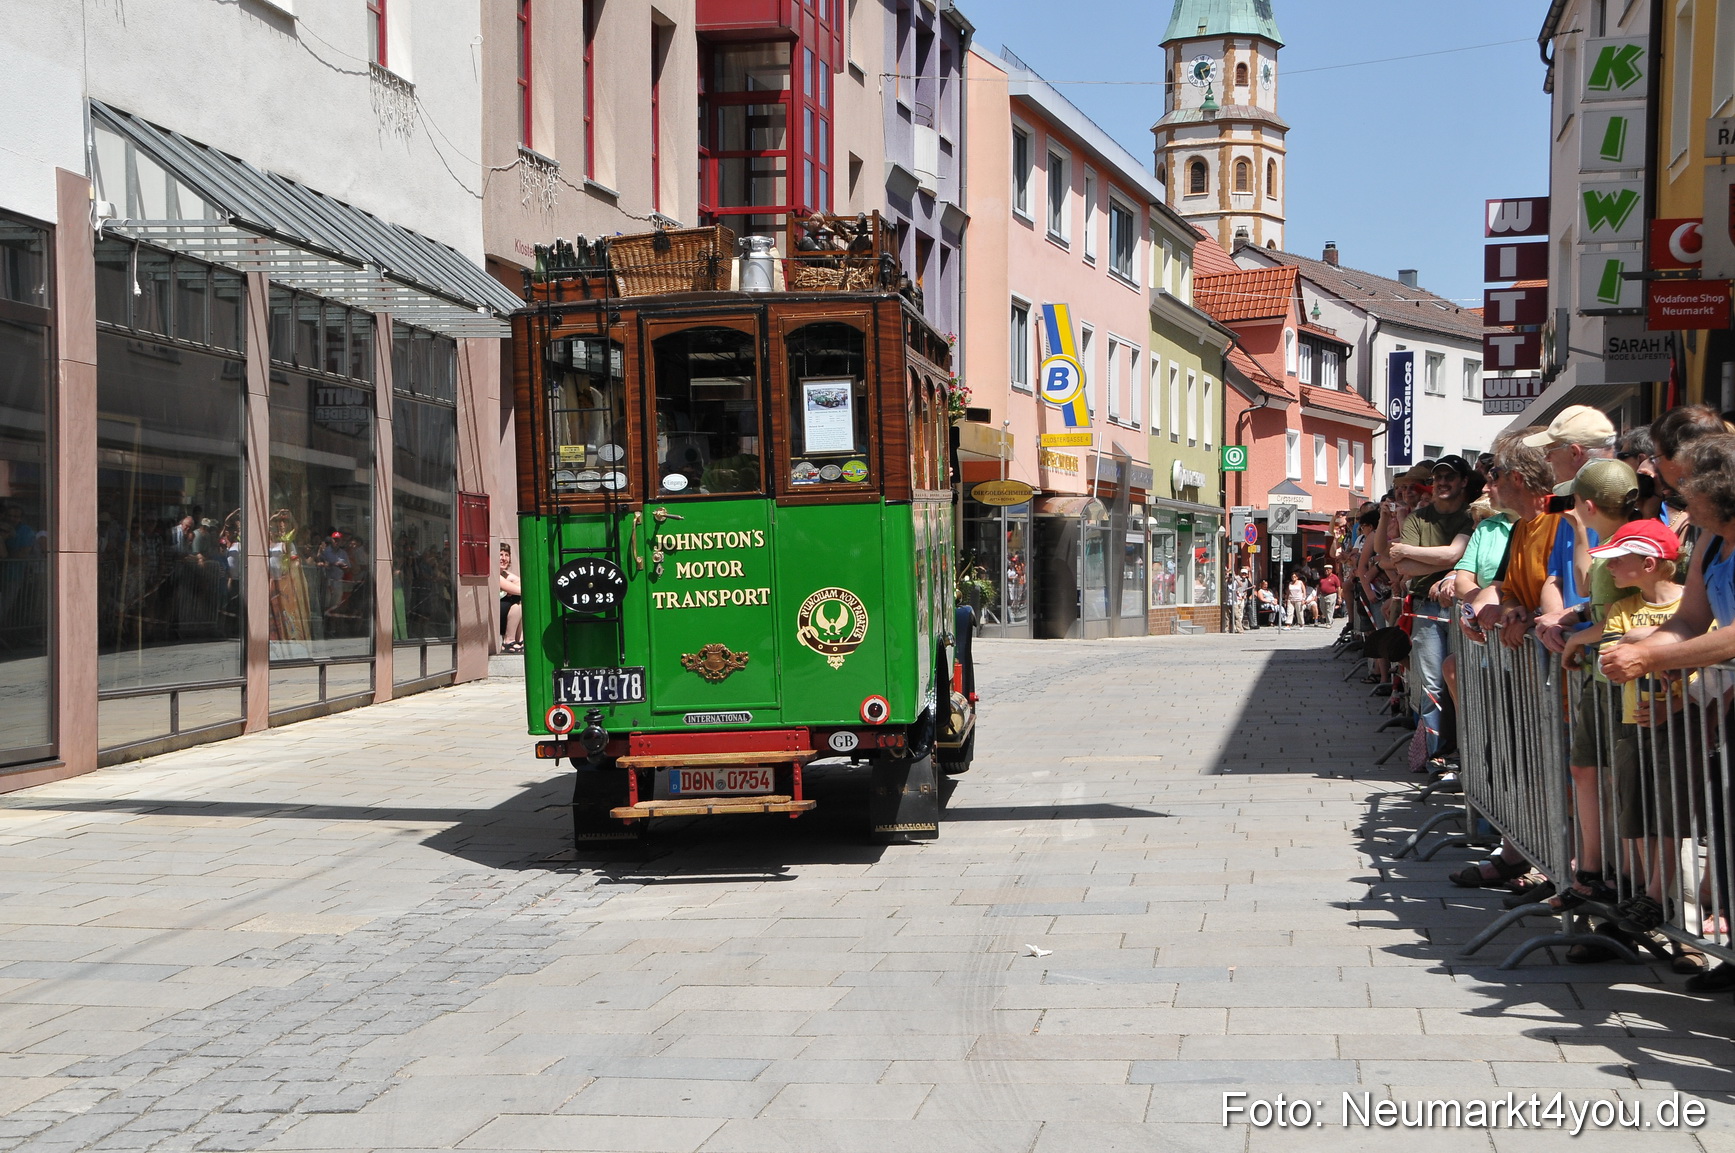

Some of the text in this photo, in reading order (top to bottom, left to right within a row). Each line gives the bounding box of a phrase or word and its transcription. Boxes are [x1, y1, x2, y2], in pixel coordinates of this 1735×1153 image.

[1582, 43, 1646, 306] KIWI
[1488, 201, 1533, 367] WITT
[1653, 294, 1725, 304] Vodafone Shop
[1662, 306, 1715, 316] Neumarkt
[1608, 337, 1660, 353] SARAH
[1638, 352, 1672, 360] LIFESTYL
[1046, 367, 1069, 391] B
[1485, 379, 1542, 398] WITT
[1404, 361, 1413, 457] TOM TAILOR
[1043, 435, 1084, 444] KLOSTERGASSE
[654, 529, 765, 551] JOHNSTON'S
[557, 562, 623, 587] Baujahr
[676, 560, 745, 579] MOTOR
[652, 588, 771, 609] TRANSPORT
[801, 590, 866, 639] NUNQUAM NON PARATUS
[688, 714, 748, 723] INTERNATIONAL
[833, 735, 854, 747] GB
[681, 770, 770, 791] DON 0754
[875, 823, 936, 831] INTERNATIONAL
